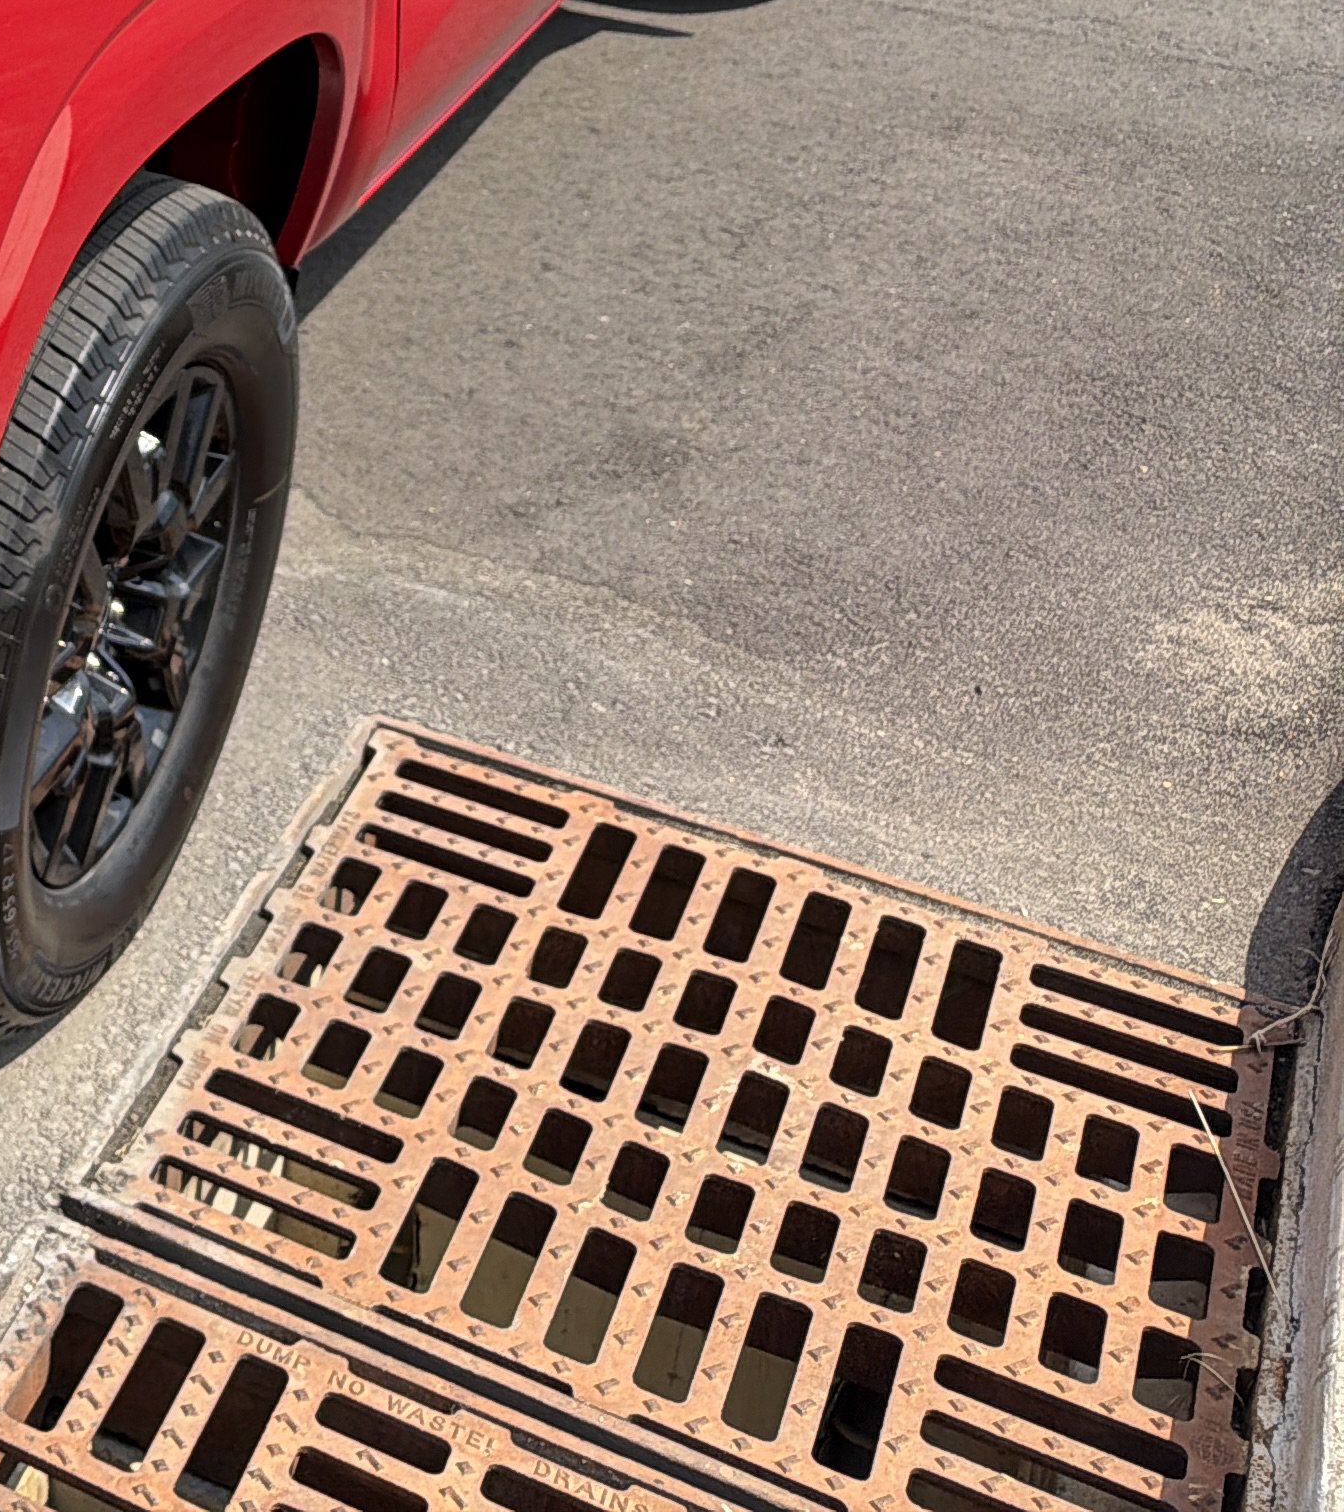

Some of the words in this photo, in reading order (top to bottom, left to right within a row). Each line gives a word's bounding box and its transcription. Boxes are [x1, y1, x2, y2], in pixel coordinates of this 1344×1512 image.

[235, 1330, 311, 1372] DUMP
[327, 1369, 366, 1397] NO
[387, 1394, 499, 1457] WASTE!
